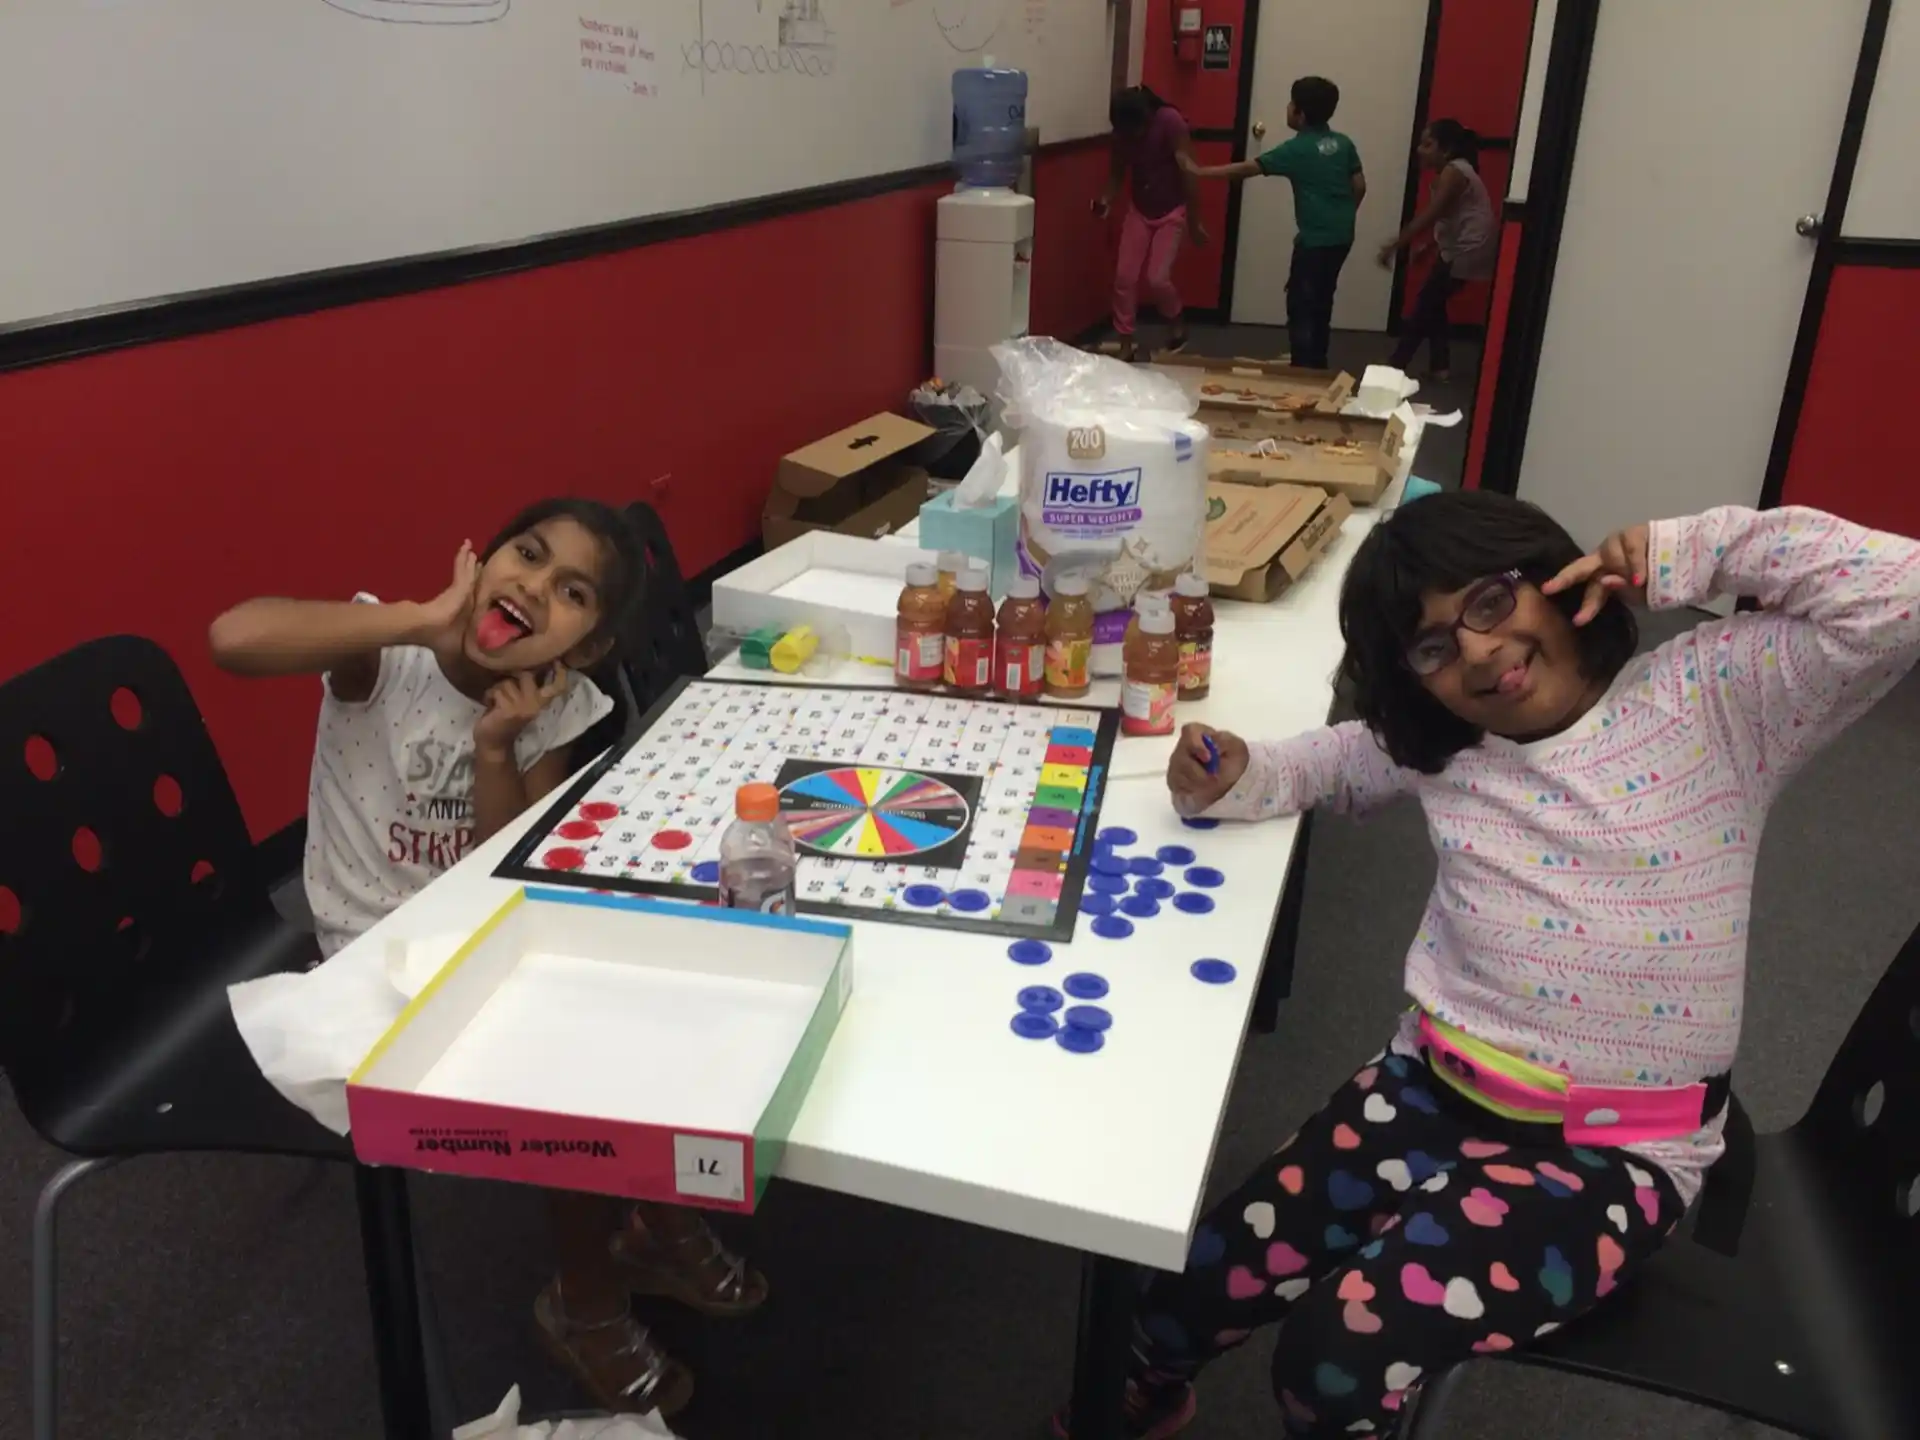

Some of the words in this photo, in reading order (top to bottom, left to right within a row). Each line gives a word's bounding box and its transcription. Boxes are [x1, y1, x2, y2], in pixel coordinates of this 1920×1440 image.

[1049, 477, 1134, 507] Hefty
[1048, 513, 1085, 524] SUPER
[1087, 511, 1134, 524] WEIGHT
[427, 798, 466, 820] AND
[415, 1138, 512, 1156] Number
[520, 1138, 618, 1157] Wonder
[699, 1156, 722, 1176] 71
